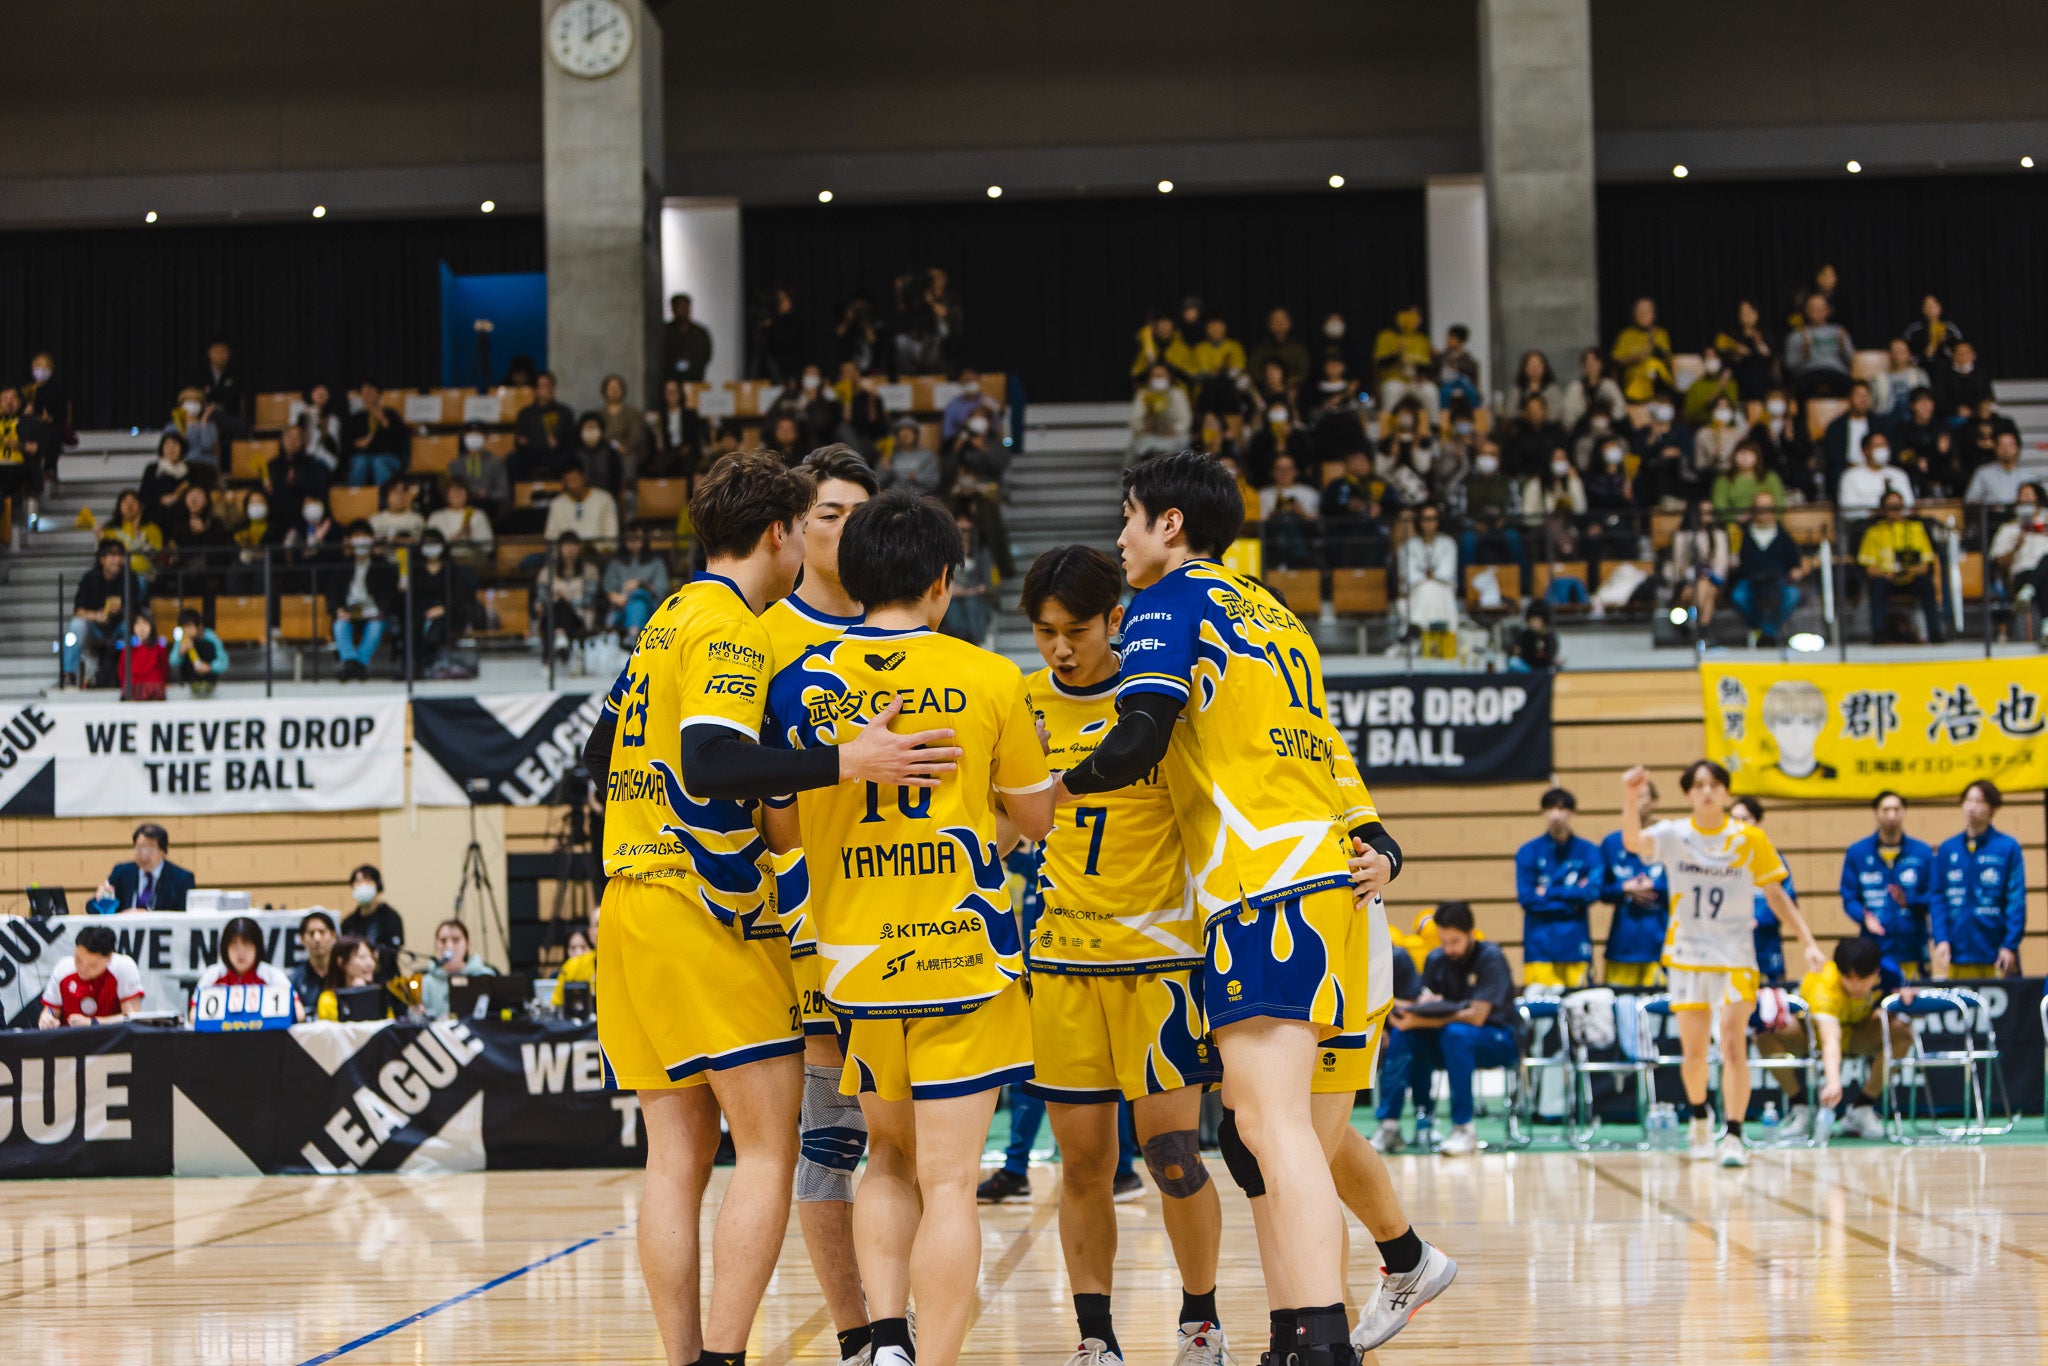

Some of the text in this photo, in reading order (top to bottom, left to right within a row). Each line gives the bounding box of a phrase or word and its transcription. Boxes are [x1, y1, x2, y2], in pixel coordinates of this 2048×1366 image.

[708, 640, 765, 664] KIKUCHI
[708, 650, 764, 671] PRODUCE
[881, 651, 907, 671] LEAGUE
[1267, 641, 1323, 719] 12
[1326, 685, 1527, 727] EVER DROP
[85, 716, 376, 753] WE NEVER DROP
[498, 693, 605, 806] LEAGU
[1367, 727, 1465, 768] BALL
[144, 758, 315, 793] THE BALL
[628, 841, 686, 856] KITAGAS
[1075, 806, 1108, 876] 7
[841, 841, 957, 880] YAMADA
[1261, 889, 1292, 902] HOKKAIDO
[1293, 883, 1317, 894] YELLOW
[1317, 879, 1336, 887] STARS
[1692, 885, 1725, 919] 19
[897, 917, 982, 939] KITAGAS
[915, 953, 984, 972] 札幌市交通局
[1066, 965, 1136, 974] HOKKAIDO YELLOW STARS
[205, 995, 219, 1018] 0
[271, 993, 280, 1015] 1
[867, 1008, 898, 1016] HOKKAIDO
[923, 1006, 945, 1014] STARS
[521, 1040, 600, 1096] WE
[301, 1019, 485, 1175] LEAGUE
